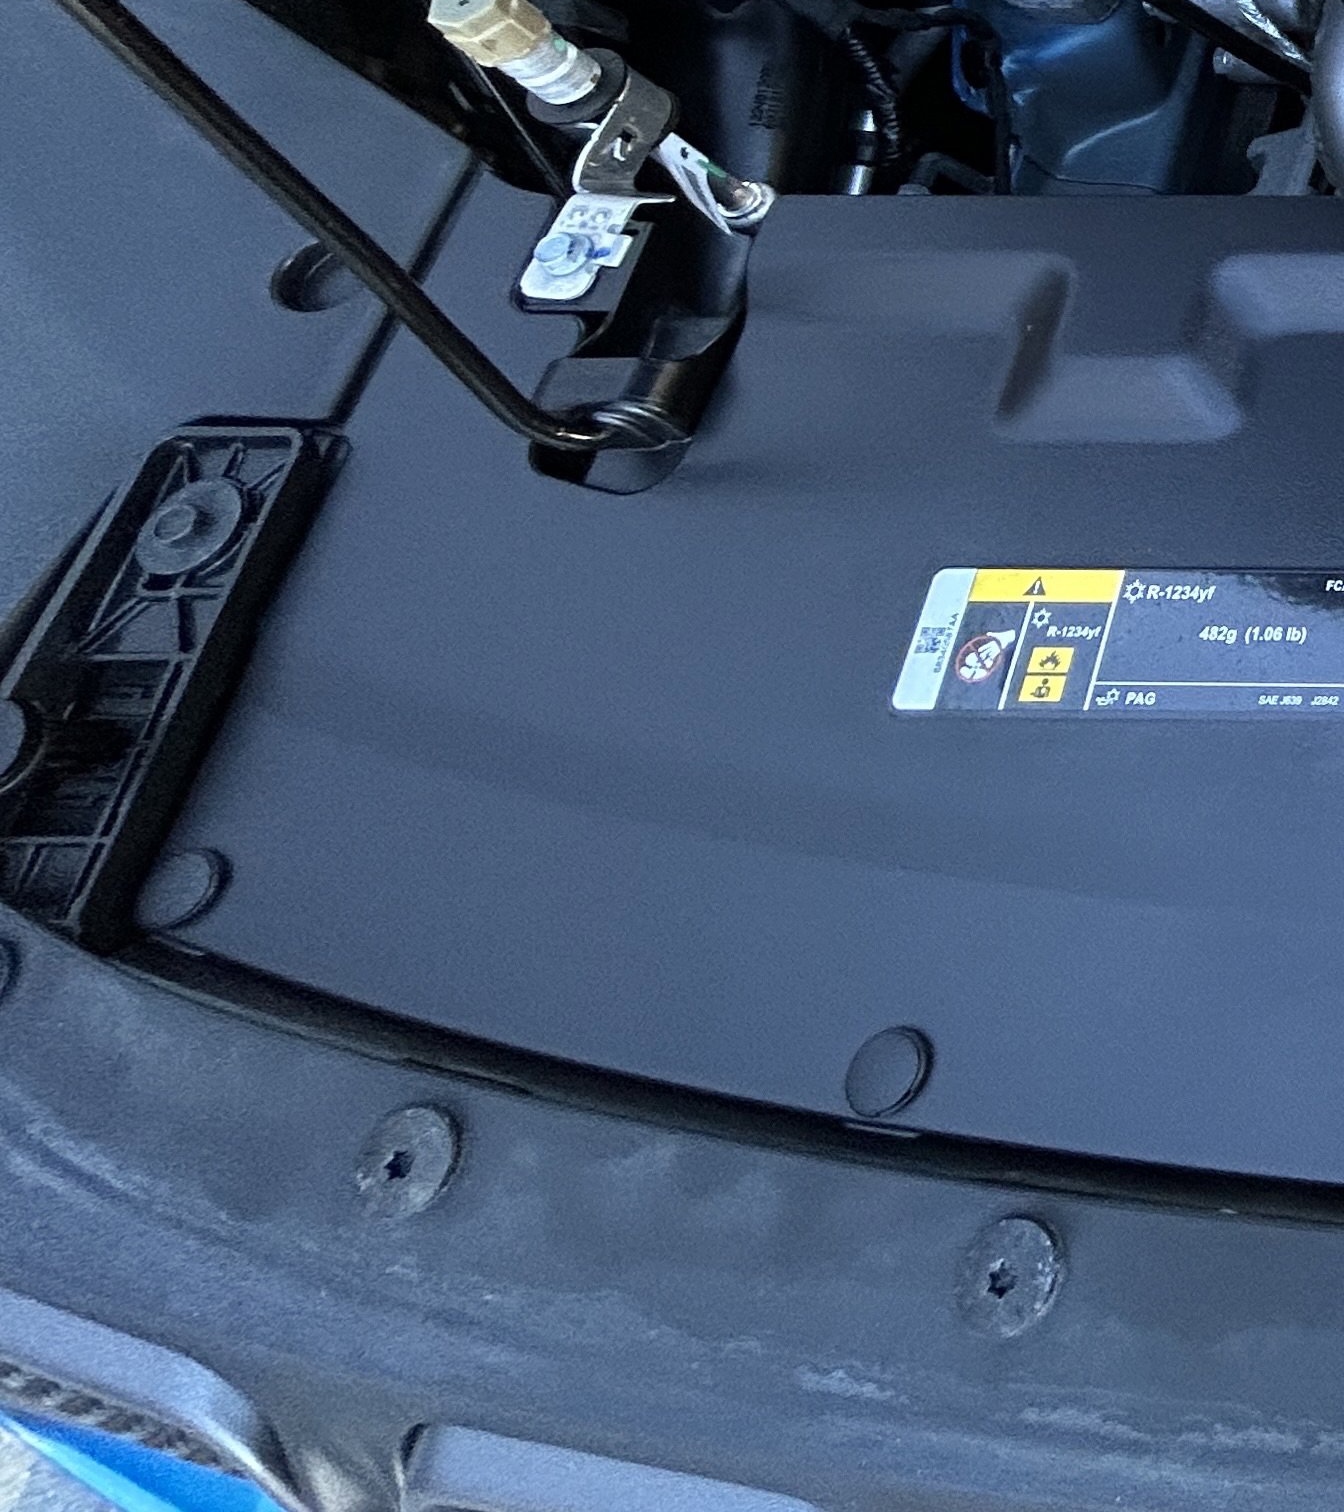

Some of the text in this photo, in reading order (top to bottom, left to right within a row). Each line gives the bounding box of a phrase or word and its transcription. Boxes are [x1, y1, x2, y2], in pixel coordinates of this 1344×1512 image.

[1147, 585, 1217, 603] R-1234yf
[1047, 626, 1102, 640] R-1234yf
[1199, 626, 1307, 645] 482g (1.06 lb)
[1124, 692, 1156, 705] PAG
[1258, 695, 1280, 705] SAE
